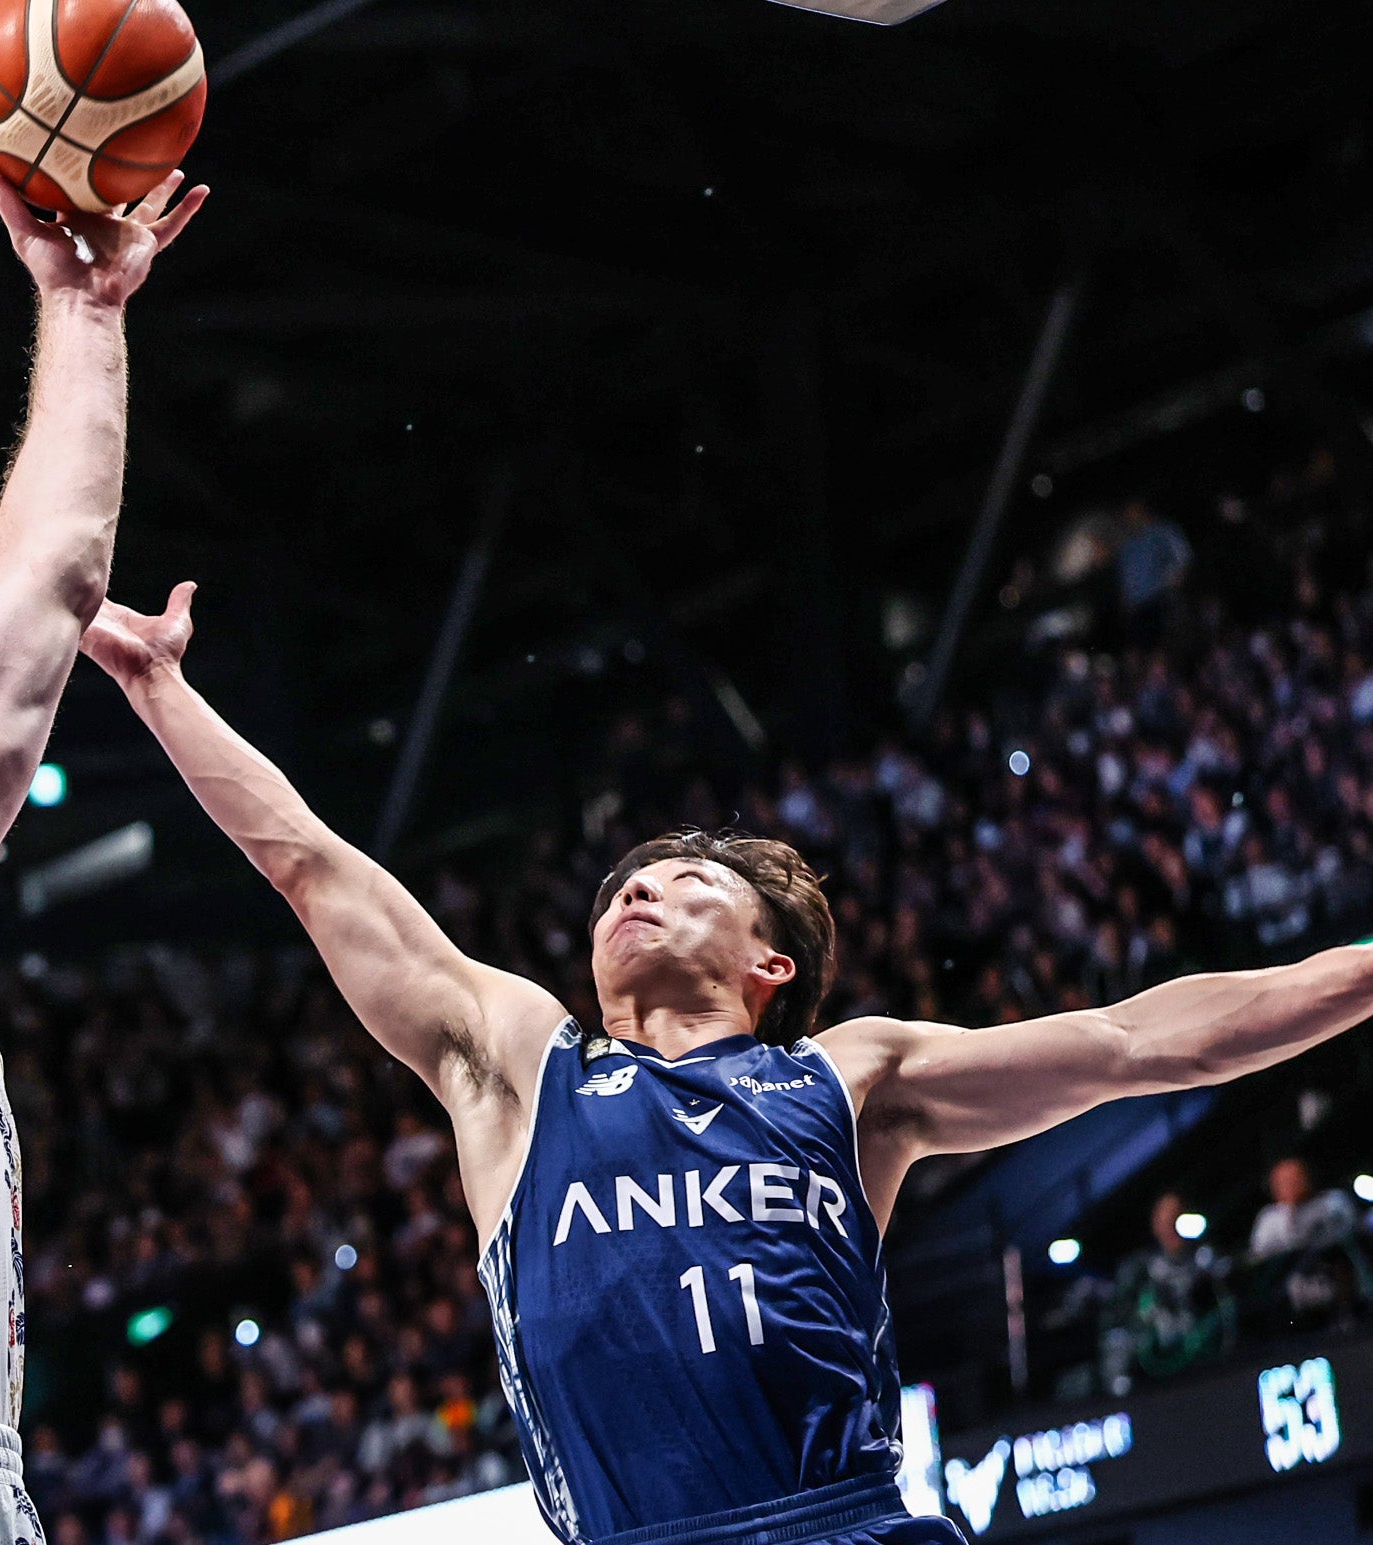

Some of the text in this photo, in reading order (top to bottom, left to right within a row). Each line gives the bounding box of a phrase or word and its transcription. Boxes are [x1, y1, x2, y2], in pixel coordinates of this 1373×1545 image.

[553, 1163, 849, 1247] ANKER
[679, 1263, 765, 1355] 11
[1258, 1356, 1340, 1473] 53
